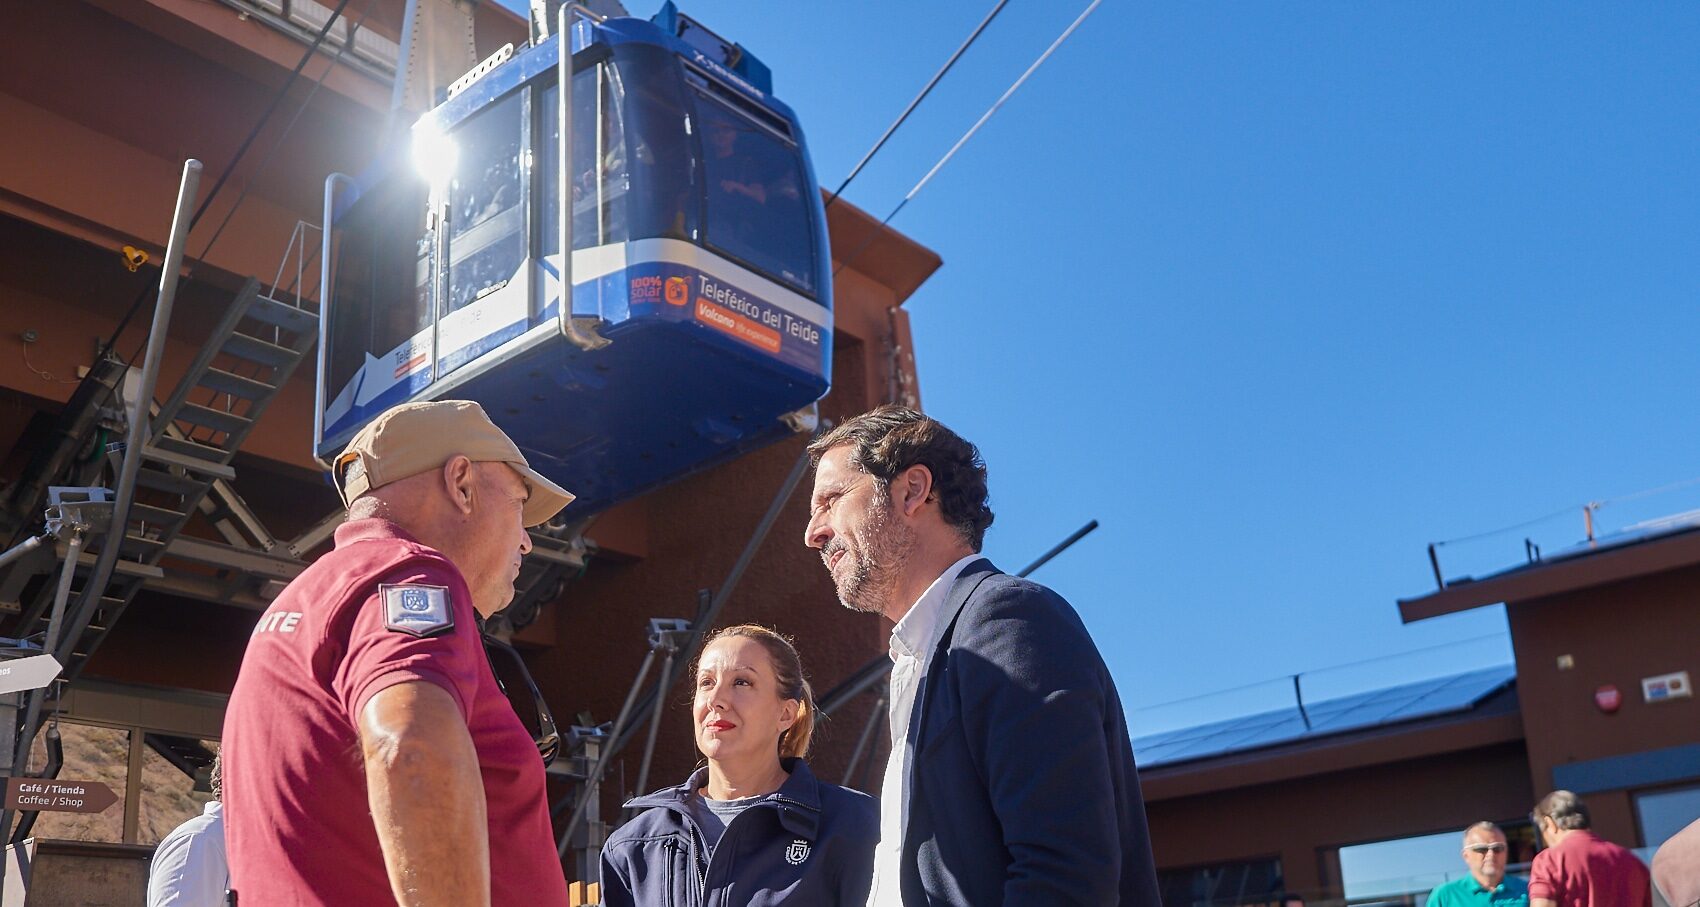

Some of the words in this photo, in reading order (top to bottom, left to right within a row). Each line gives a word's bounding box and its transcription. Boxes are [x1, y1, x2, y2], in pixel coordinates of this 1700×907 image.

[631, 276, 662, 288] 100%
[631, 286, 662, 299] solar
[698, 275, 760, 319] Teleférico
[762, 309, 782, 329] del
[784, 314, 819, 345] Teide
[700, 303, 735, 328] Volcano
[20, 784, 42, 793] Café
[44, 785, 50, 794] /
[52, 785, 85, 795] Tienda
[18, 795, 50, 805] Coffee
[51, 797, 57, 806] /
[59, 797, 83, 808] Shop
